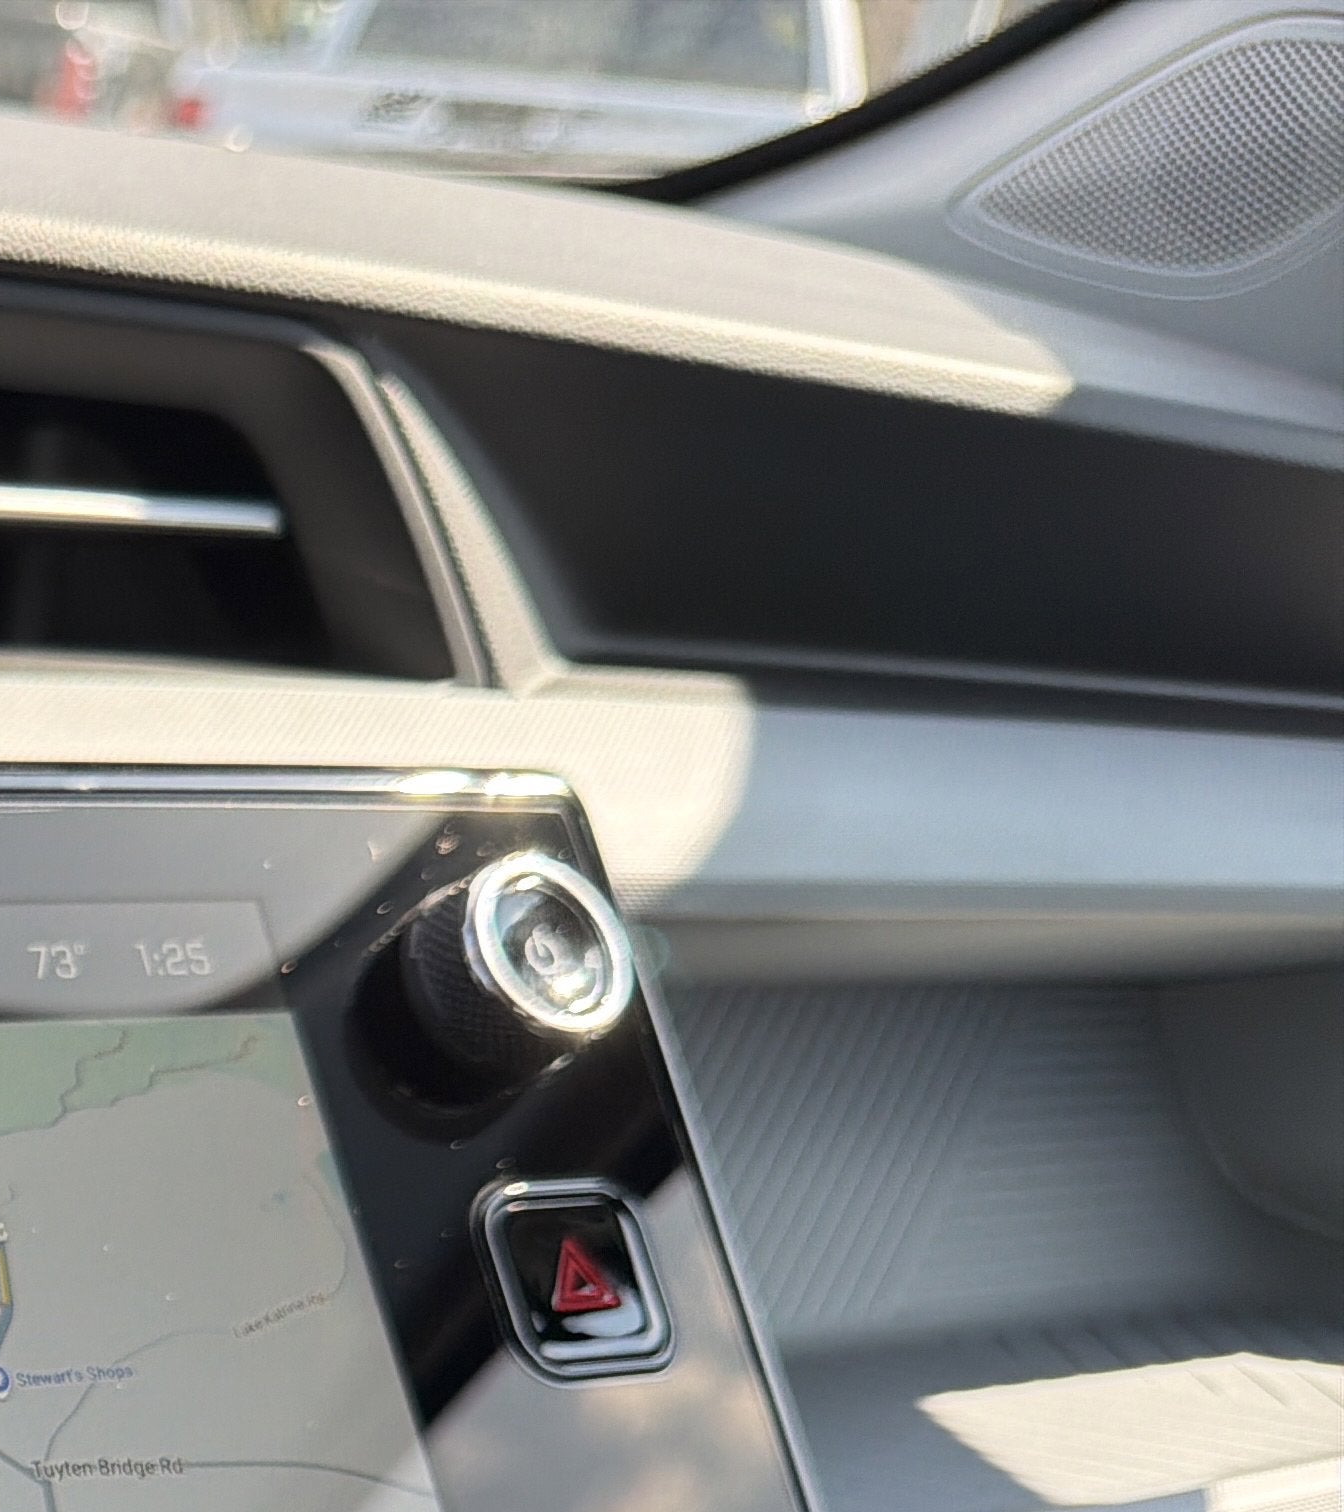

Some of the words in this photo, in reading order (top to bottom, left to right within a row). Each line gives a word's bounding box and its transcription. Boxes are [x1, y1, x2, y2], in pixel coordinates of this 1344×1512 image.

[27, 943, 87, 979] 73°
[133, 941, 212, 977] 1:25
[16, 1367, 83, 1387] Stewart's
[86, 1364, 134, 1383] Shops
[32, 1460, 94, 1481] Tuyten
[98, 1457, 154, 1480] Bridge
[159, 1457, 184, 1475] Rd
